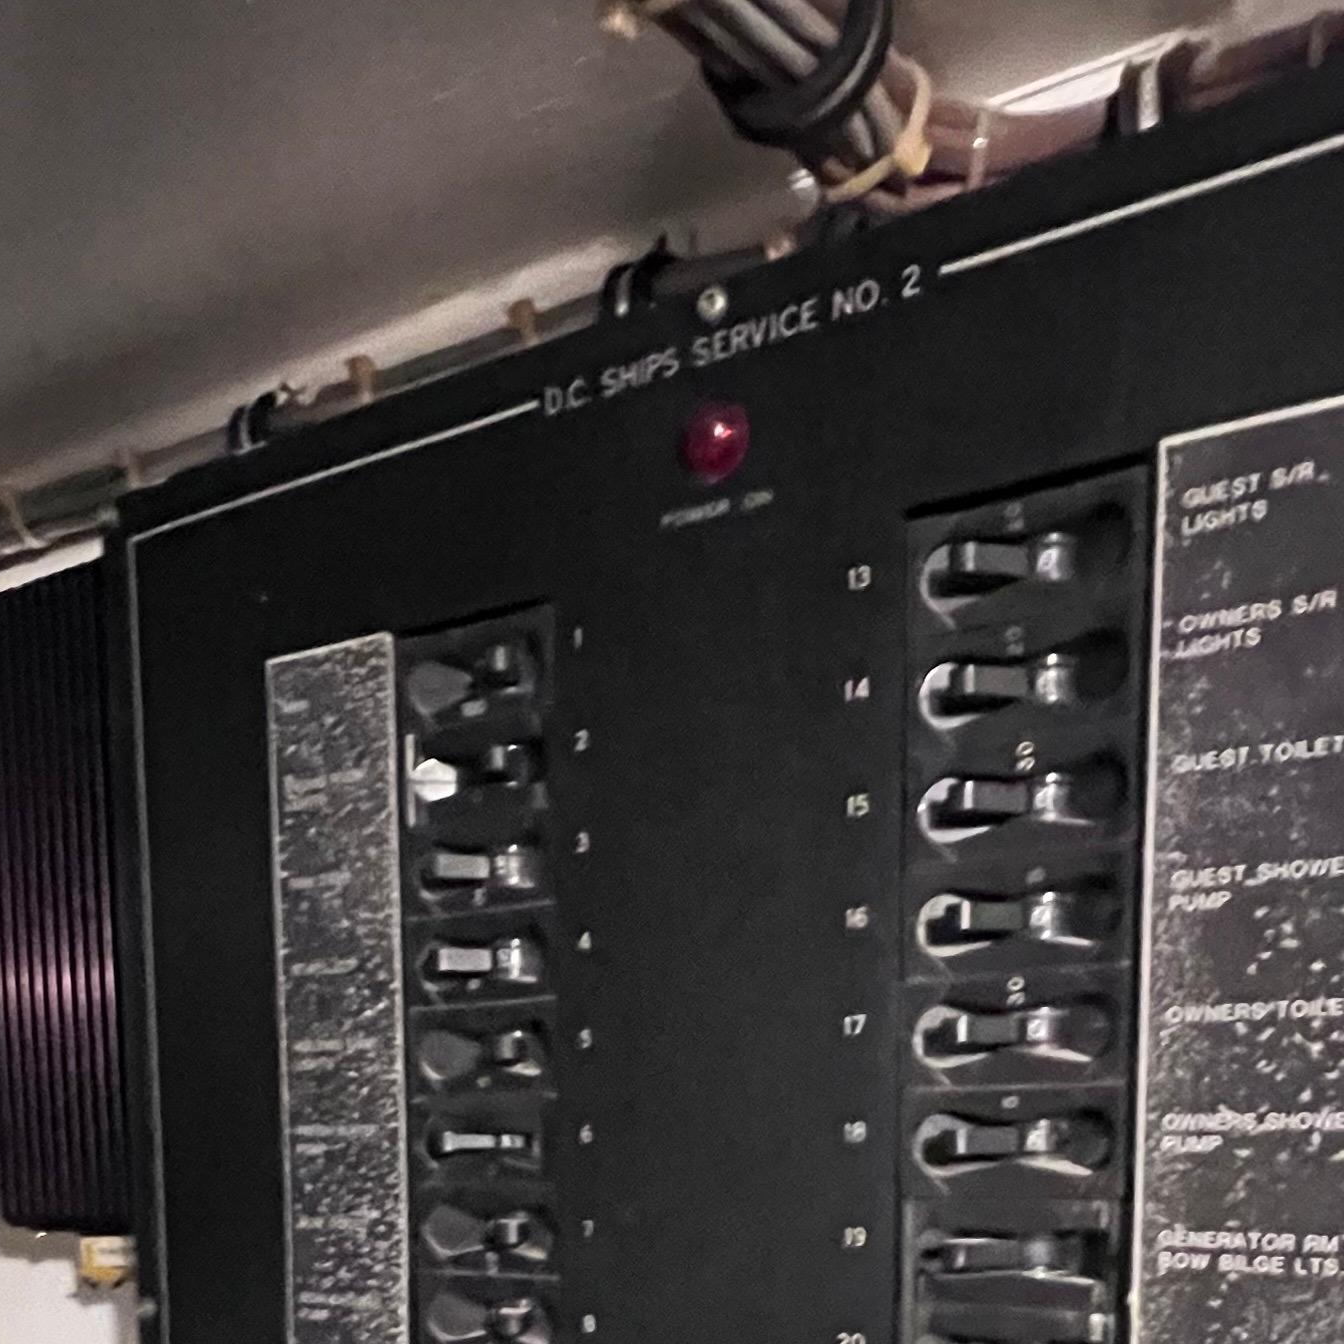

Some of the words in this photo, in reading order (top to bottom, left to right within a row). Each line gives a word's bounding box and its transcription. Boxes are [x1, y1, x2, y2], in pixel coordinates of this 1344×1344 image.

[599, 346, 680, 398] SHIPS
[691, 297, 820, 368] SERVICE
[831, 279, 888, 321] NO.
[901, 264, 922, 299] 2
[1181, 472, 1262, 509] GUEST
[1181, 499, 1268, 536] LIGHTS
[847, 566, 872, 590] 13
[1178, 599, 1281, 634] OWNERS
[1173, 628, 1261, 660] LIGHTS
[844, 677, 870, 701] 14
[574, 728, 589, 751] 2
[1172, 746, 1249, 775] GUEST
[846, 794, 870, 818] 15
[575, 831, 591, 853] 3
[1170, 864, 1246, 890] GUEST
[1167, 890, 1232, 911] PUMP
[845, 906, 869, 929] 16
[843, 1014, 867, 1037] 17
[1159, 1134, 1223, 1152] PUMP
[1157, 1230, 1297, 1252] GENERATOR
[1157, 1251, 1212, 1272] BOW
[1217, 1255, 1286, 1274] BILGE
